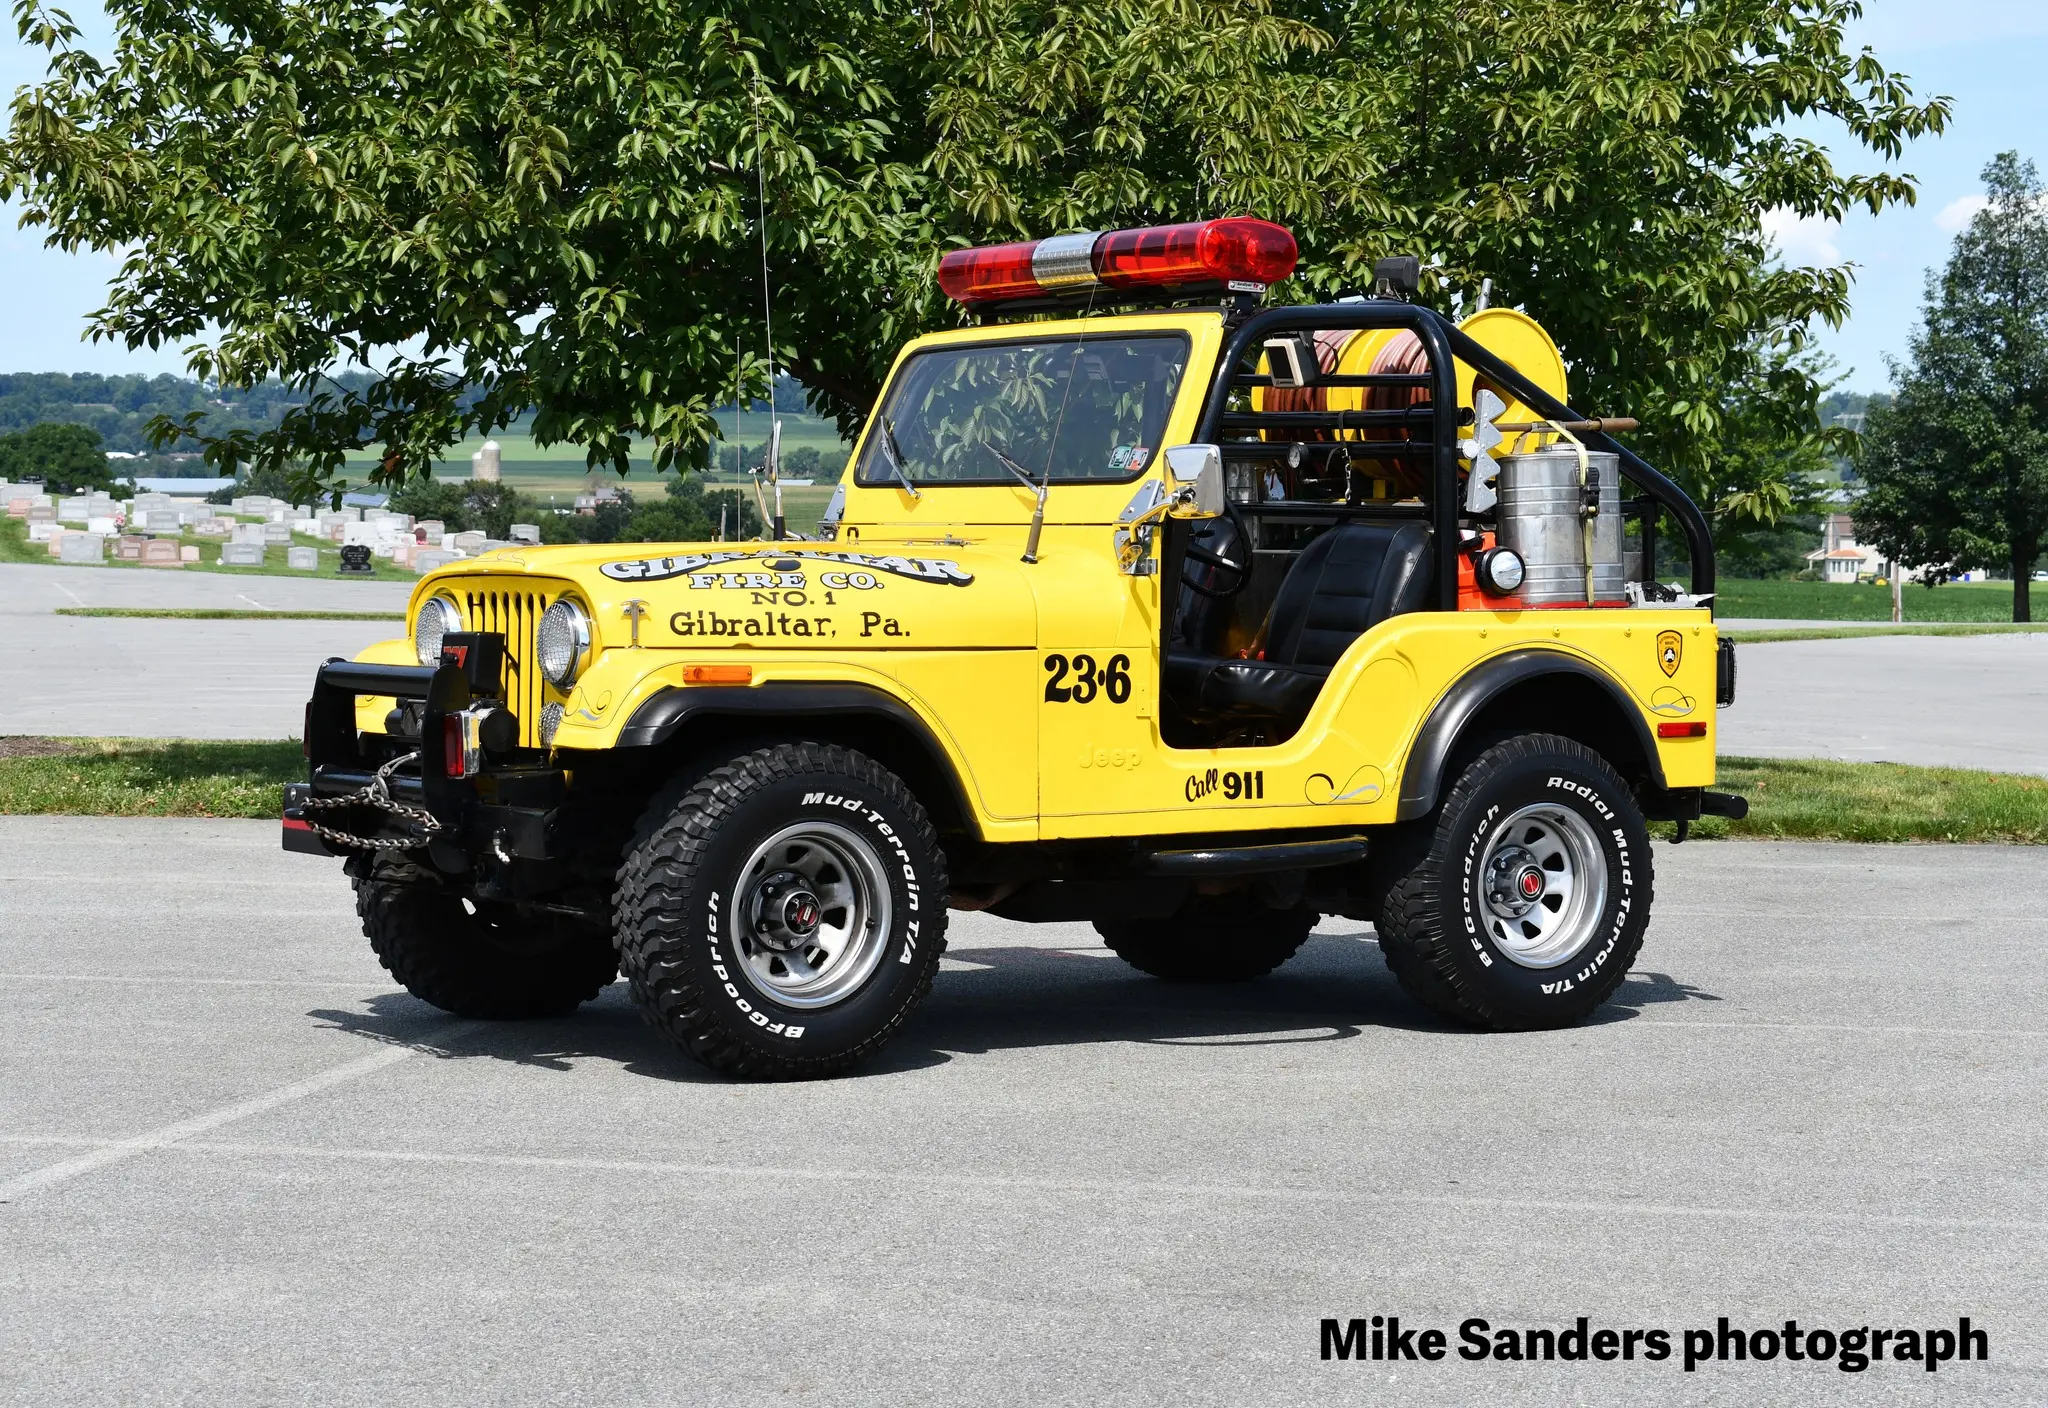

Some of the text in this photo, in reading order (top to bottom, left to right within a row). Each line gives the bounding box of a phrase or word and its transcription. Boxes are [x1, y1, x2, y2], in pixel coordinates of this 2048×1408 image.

[687, 571, 886, 590] FIRE CO.
[751, 590, 837, 608] NO. 1
[668, 609, 911, 640] Gibraltar, Pa.
[1078, 742, 1143, 771] Jeep
[1185, 768, 1264, 803] Call 911
[801, 792, 920, 965] Mud-Terrain T/A
[1462, 804, 1500, 968] BFGoodrich
[1540, 776, 1633, 995] Radial Mud-Terrain T/A
[706, 890, 806, 1039] BFGoodrich
